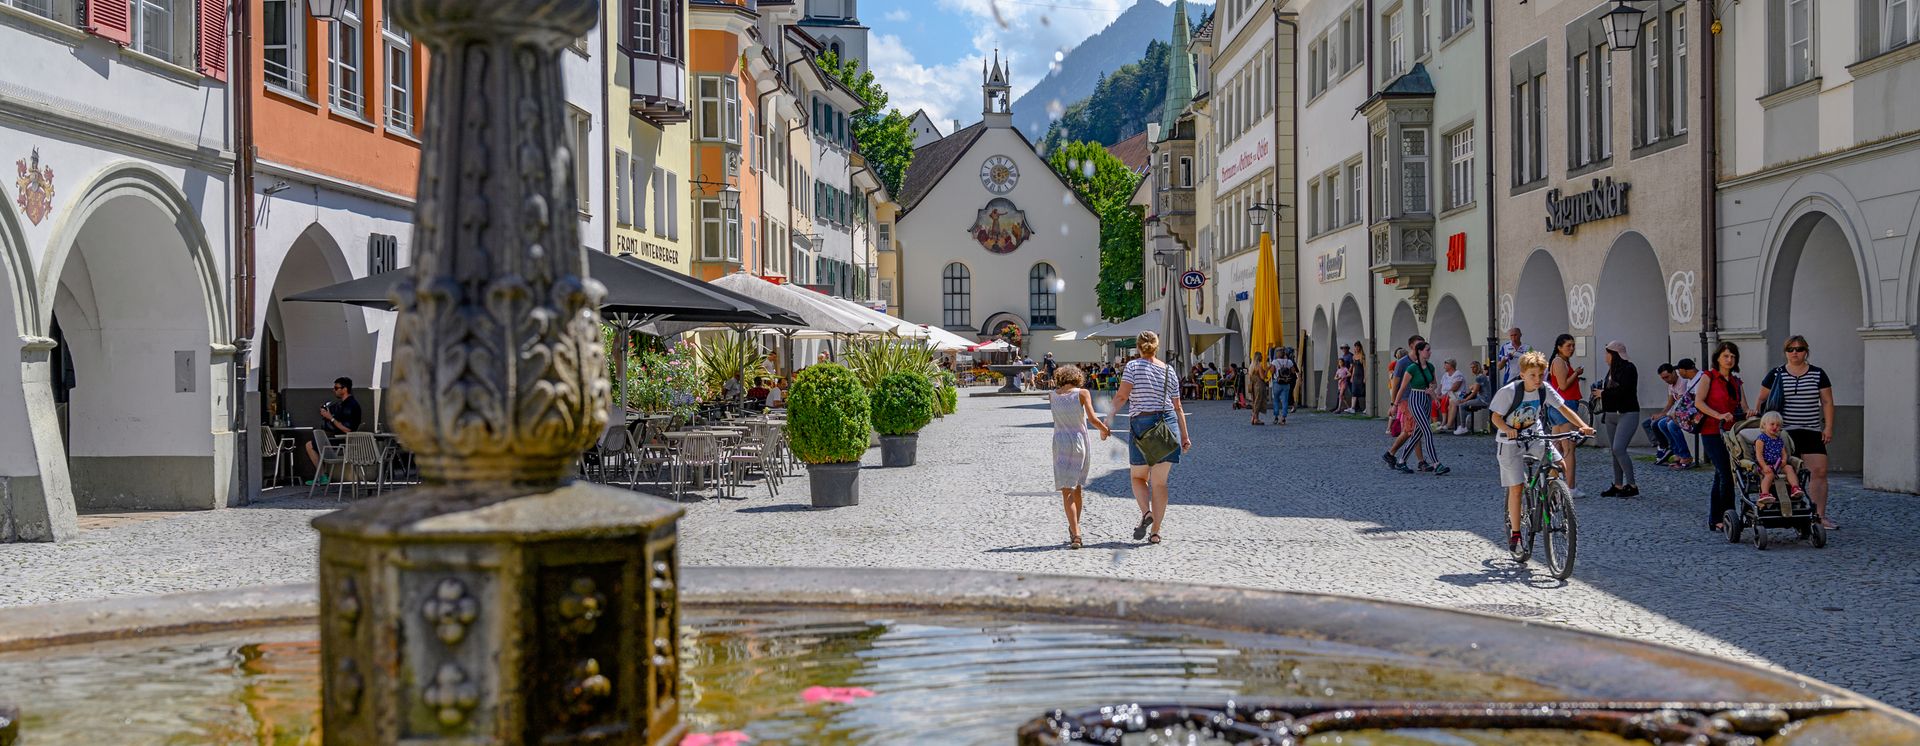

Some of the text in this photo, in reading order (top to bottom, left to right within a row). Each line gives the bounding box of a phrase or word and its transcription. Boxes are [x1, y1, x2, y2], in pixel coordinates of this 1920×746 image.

[1546, 176, 1631, 235] Sagmeister
[617, 235, 638, 254] FRANZ
[1184, 274, 1202, 285] C&A
